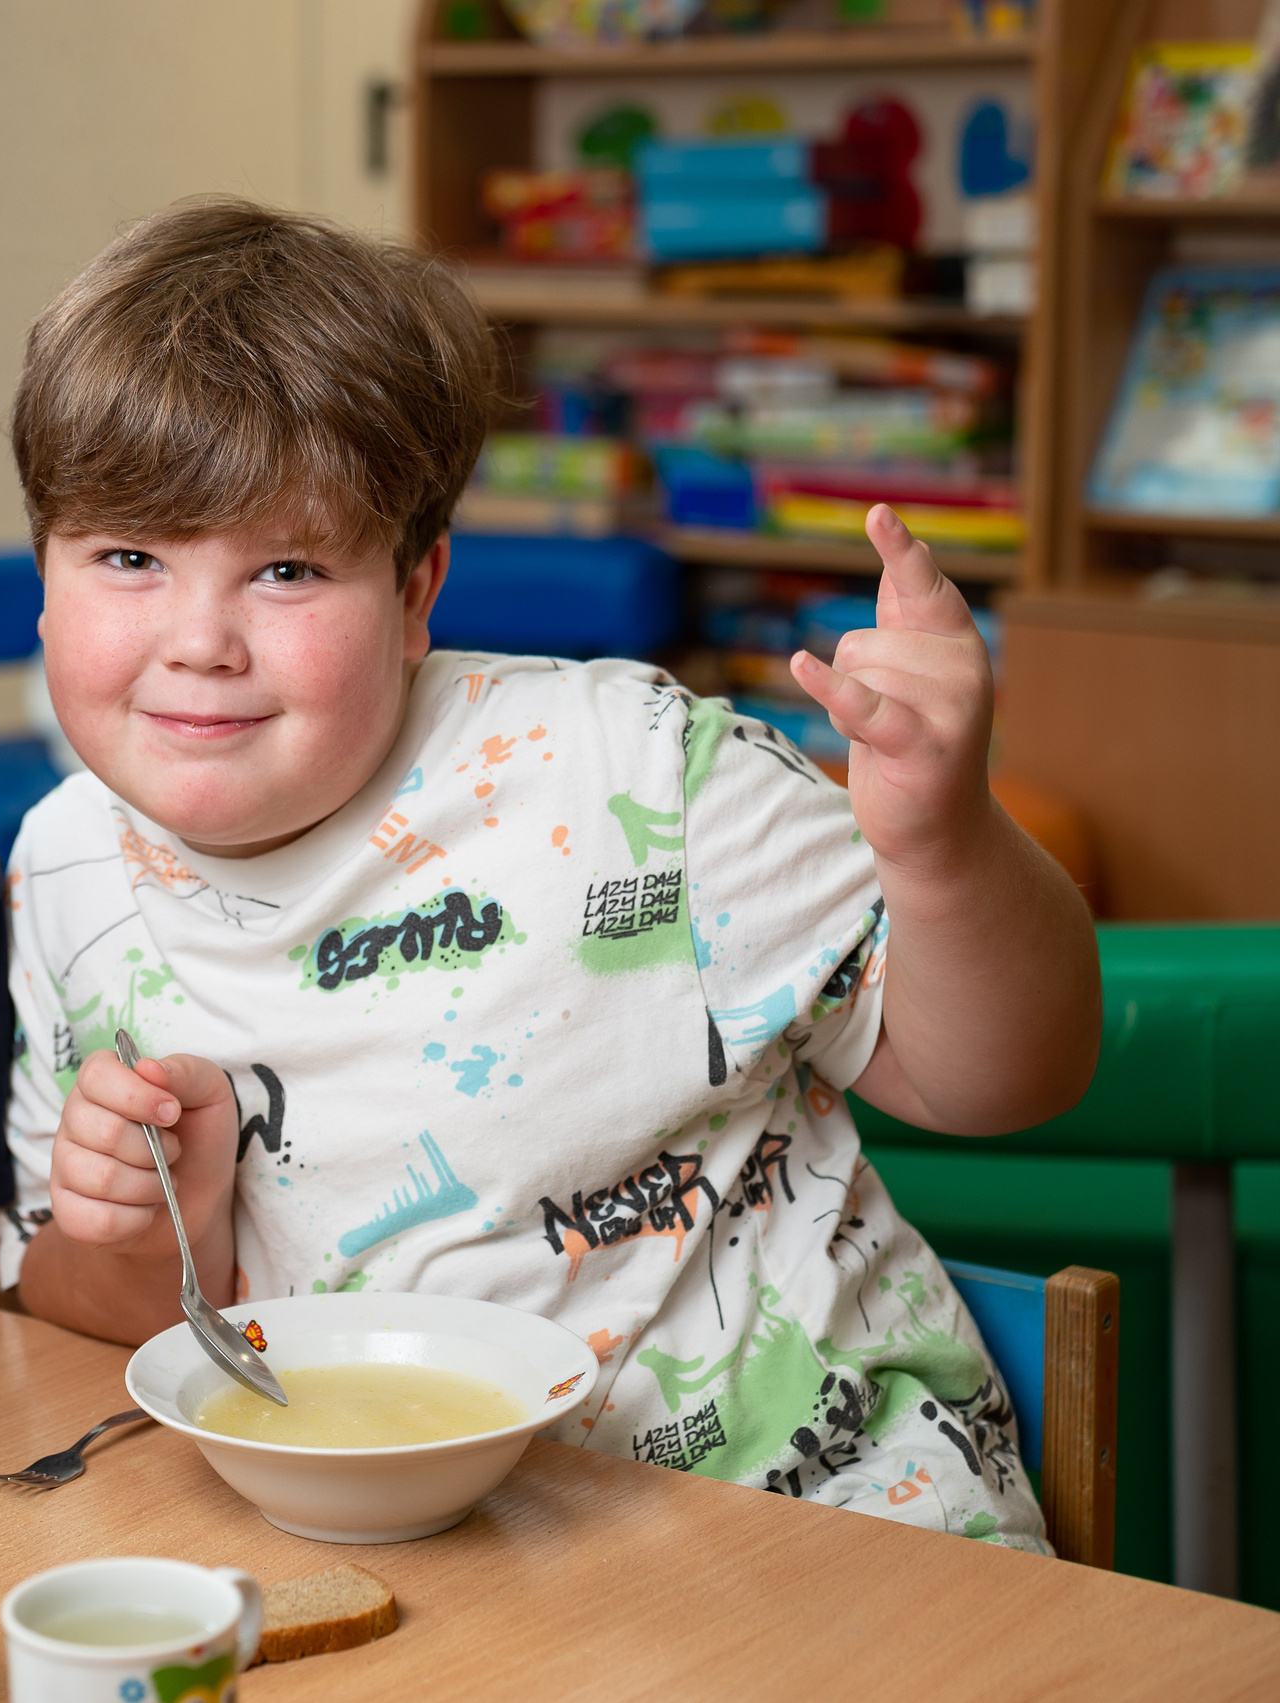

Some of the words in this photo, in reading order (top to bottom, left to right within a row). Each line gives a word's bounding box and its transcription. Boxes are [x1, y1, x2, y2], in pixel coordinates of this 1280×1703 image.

[586, 877, 638, 900] LAZY
[643, 869, 682, 890] DAY
[584, 895, 636, 918] LAZY
[640, 887, 680, 909] DAY
[582, 914, 635, 936] LAZY
[639, 906, 679, 927] DAY
[538, 1150, 719, 1255] NEVER
[633, 1422, 679, 1451] LAZY
[682, 1399, 717, 1431] DAY
[685, 1415, 722, 1447] DAY
[689, 1430, 727, 1460] DAY
